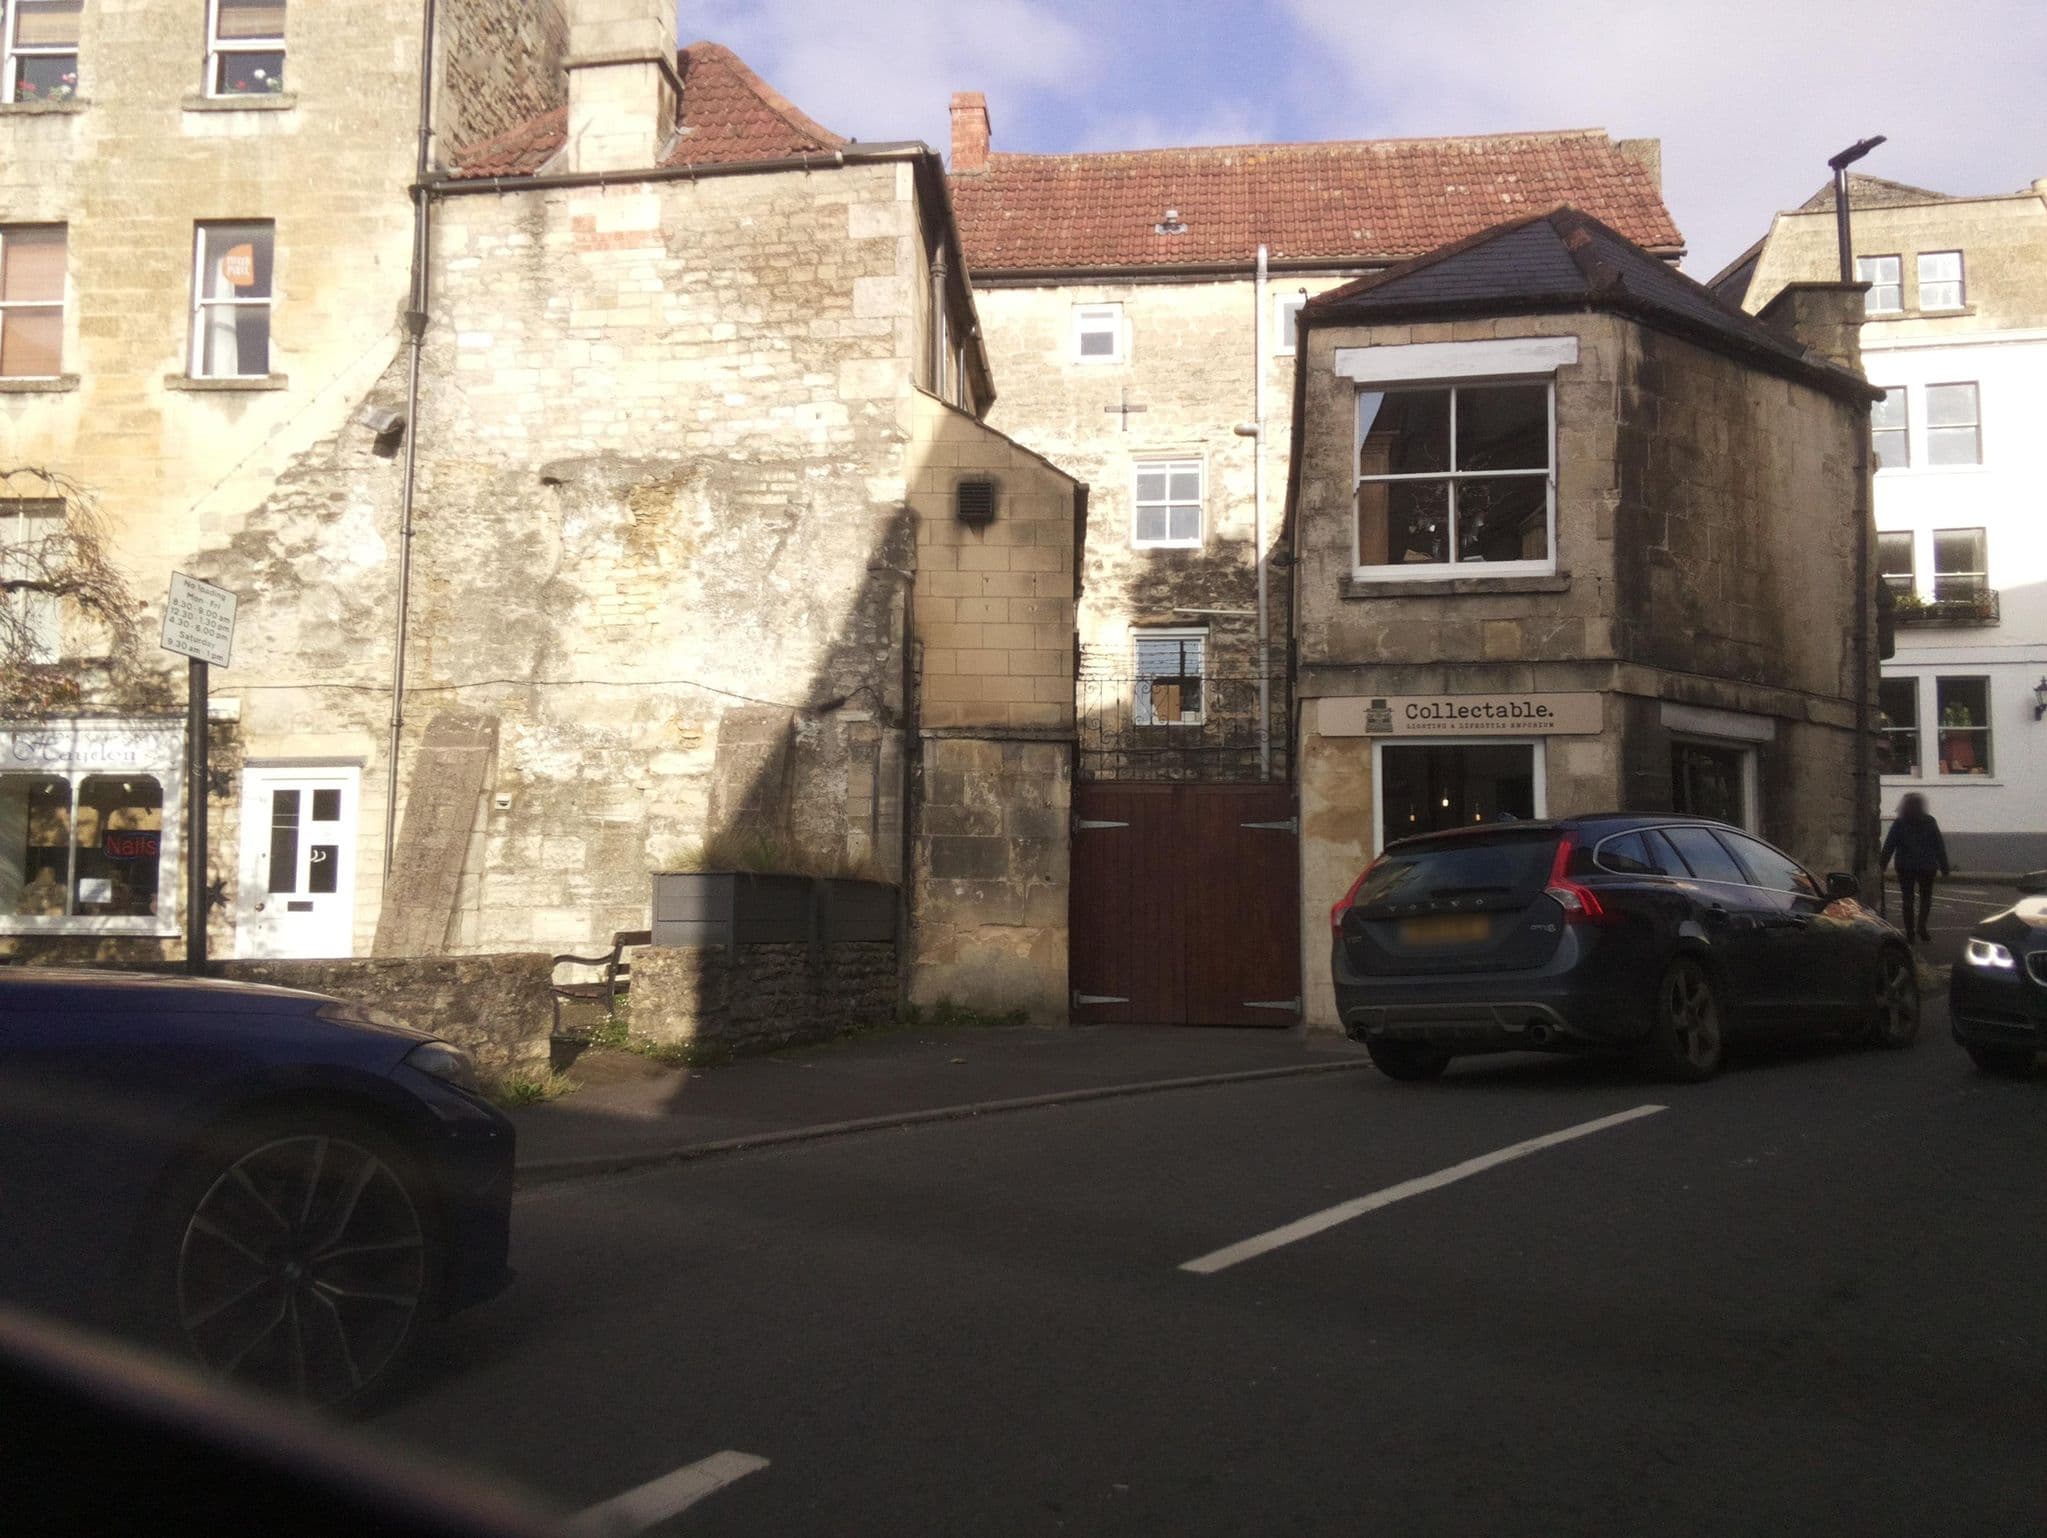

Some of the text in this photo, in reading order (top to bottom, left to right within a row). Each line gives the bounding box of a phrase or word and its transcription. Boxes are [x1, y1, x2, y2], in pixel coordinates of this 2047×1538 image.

[184, 579, 227, 602] No loading
[186, 591, 204, 604] Mon
[210, 600, 221, 610] Fri
[170, 606, 194, 620] 12.30
[199, 616, 217, 628] 1.30
[217, 624, 230, 633] pm
[172, 597, 193, 610] 8.30
[198, 606, 218, 619] 9.00
[219, 615, 231, 624] am
[168, 615, 190, 628] 4.30
[195, 624, 215, 637] 6.00
[215, 632, 228, 641] pm
[167, 637, 188, 650] 9.30
[188, 646, 201, 655] am
[211, 654, 224, 662] pm
[179, 630, 216, 649] Saturday
[1405, 702, 1554, 720] Collectable.
[1510, 721, 1554, 729] EMPORIUM
[107, 834, 157, 856] Nails
